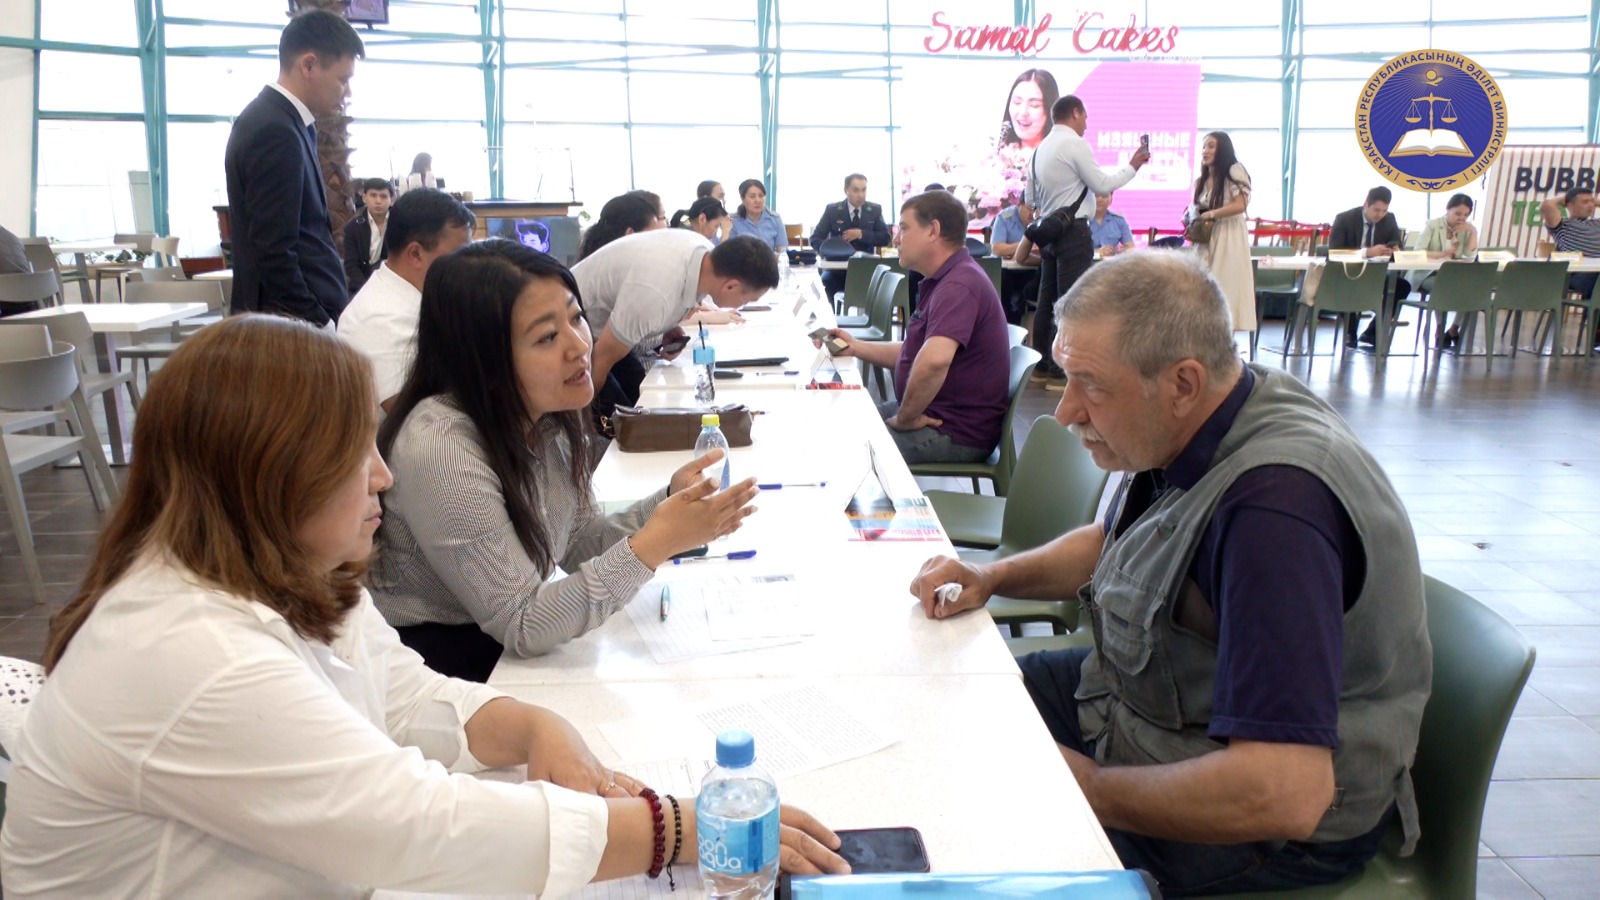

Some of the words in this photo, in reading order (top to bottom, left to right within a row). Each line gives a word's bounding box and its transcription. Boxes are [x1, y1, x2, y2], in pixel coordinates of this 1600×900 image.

[924, 11, 1052, 54] Samal
[1072, 9, 1180, 54] Cakes
[1514, 167, 1600, 193] BUBB
